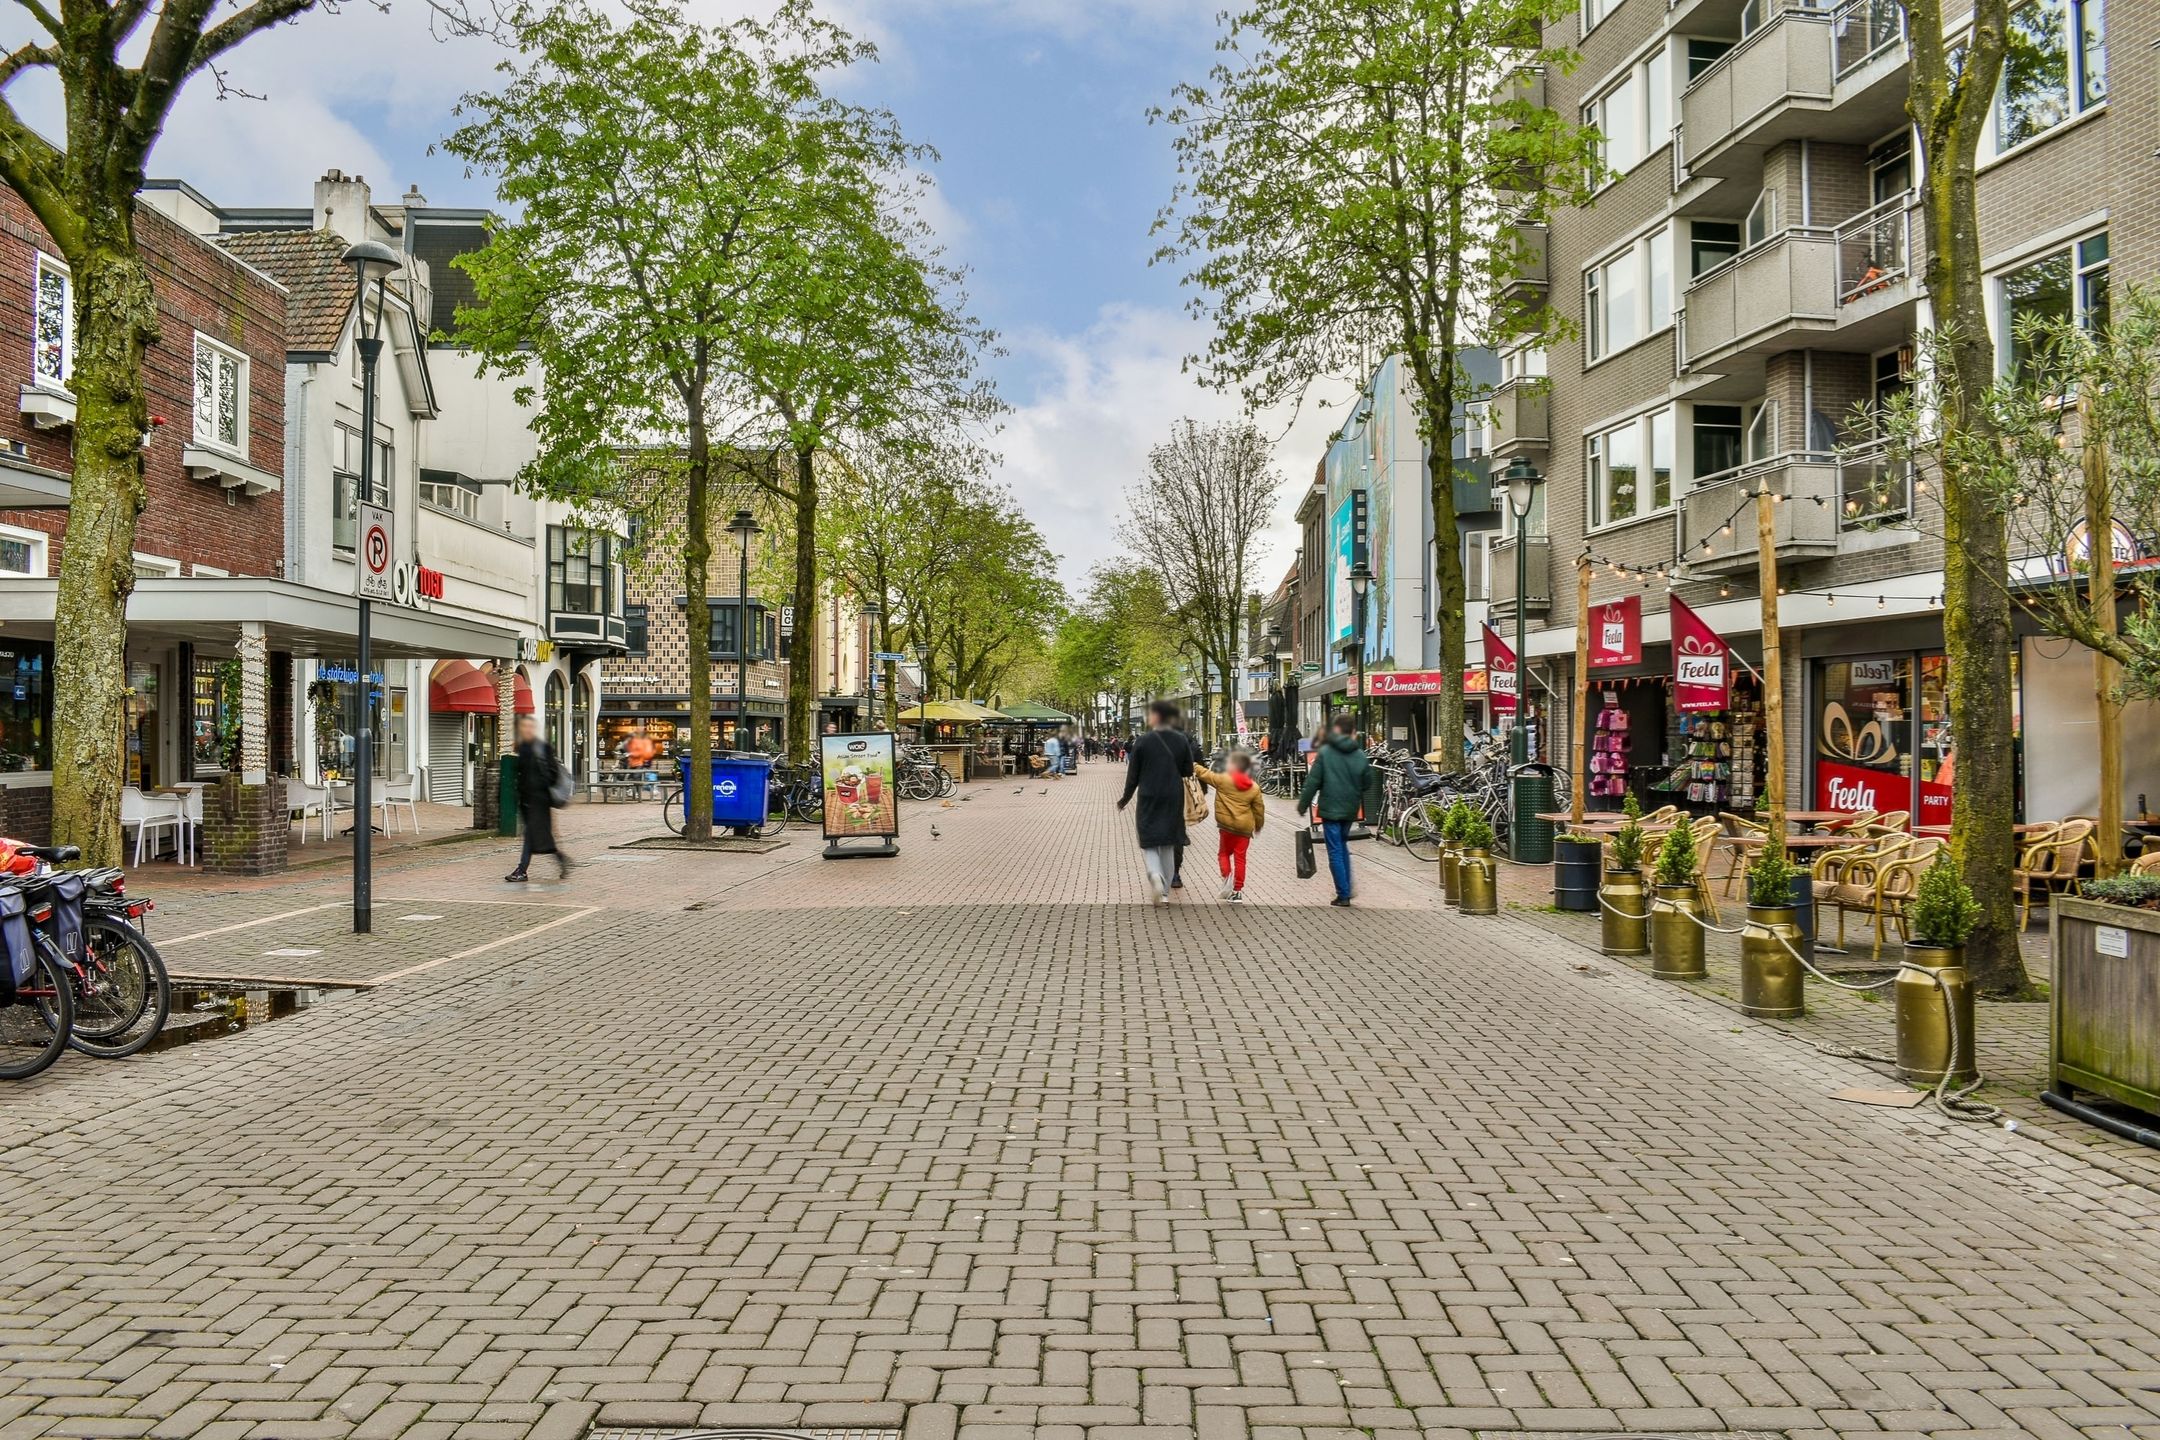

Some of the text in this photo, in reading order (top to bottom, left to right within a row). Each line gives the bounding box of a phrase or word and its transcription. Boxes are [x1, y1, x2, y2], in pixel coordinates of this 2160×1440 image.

[372, 511, 384, 521] VAK
[394, 560, 422, 608] OK
[1605, 629, 1622, 645] Feela
[521, 638, 554, 662] SUBWAY
[1680, 661, 1720, 679] Feela
[1384, 675, 1437, 691] Damascino
[1828, 777, 1875, 811] Feela
[1923, 795, 1949, 806] PARTY
